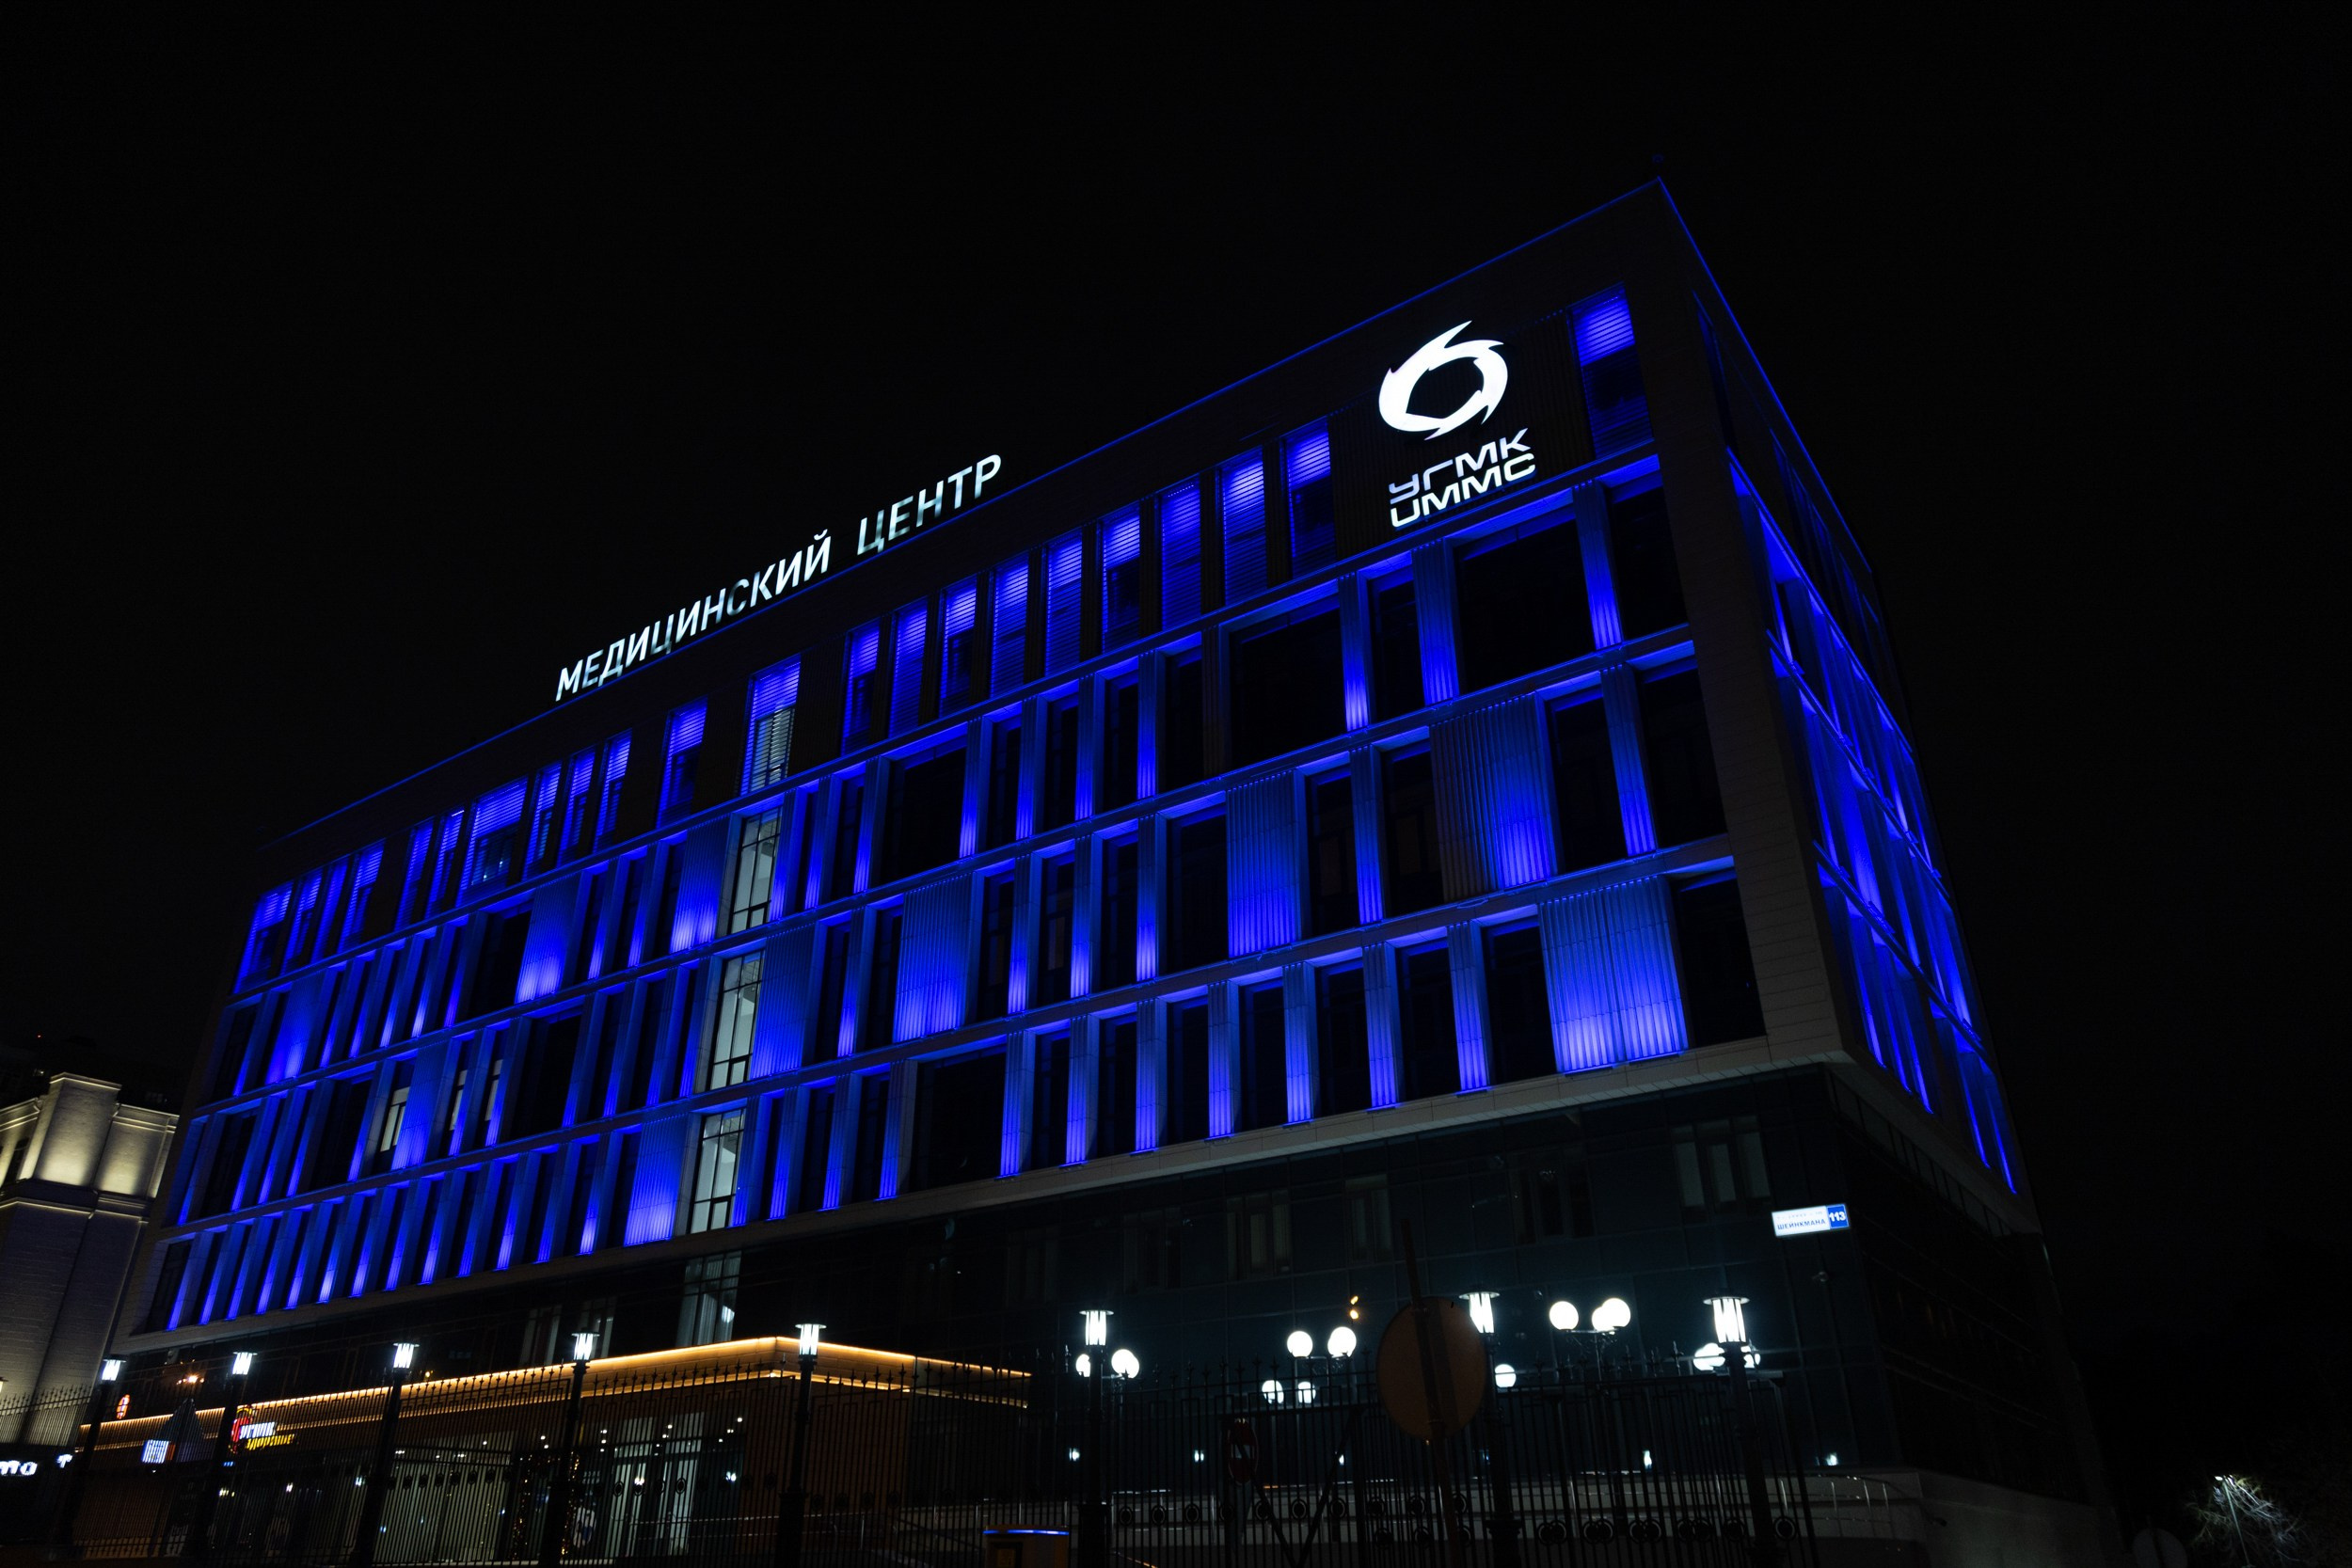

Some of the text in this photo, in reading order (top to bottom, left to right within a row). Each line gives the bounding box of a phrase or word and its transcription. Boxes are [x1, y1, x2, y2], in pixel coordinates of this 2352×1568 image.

[1389, 428, 1531, 504] УГМК
[1391, 453, 1535, 527] UMMC
[556, 454, 1002, 702] МЕДИЦИНСКИЙ ЦЕНТР
[1829, 1211, 1846, 1222] 113
